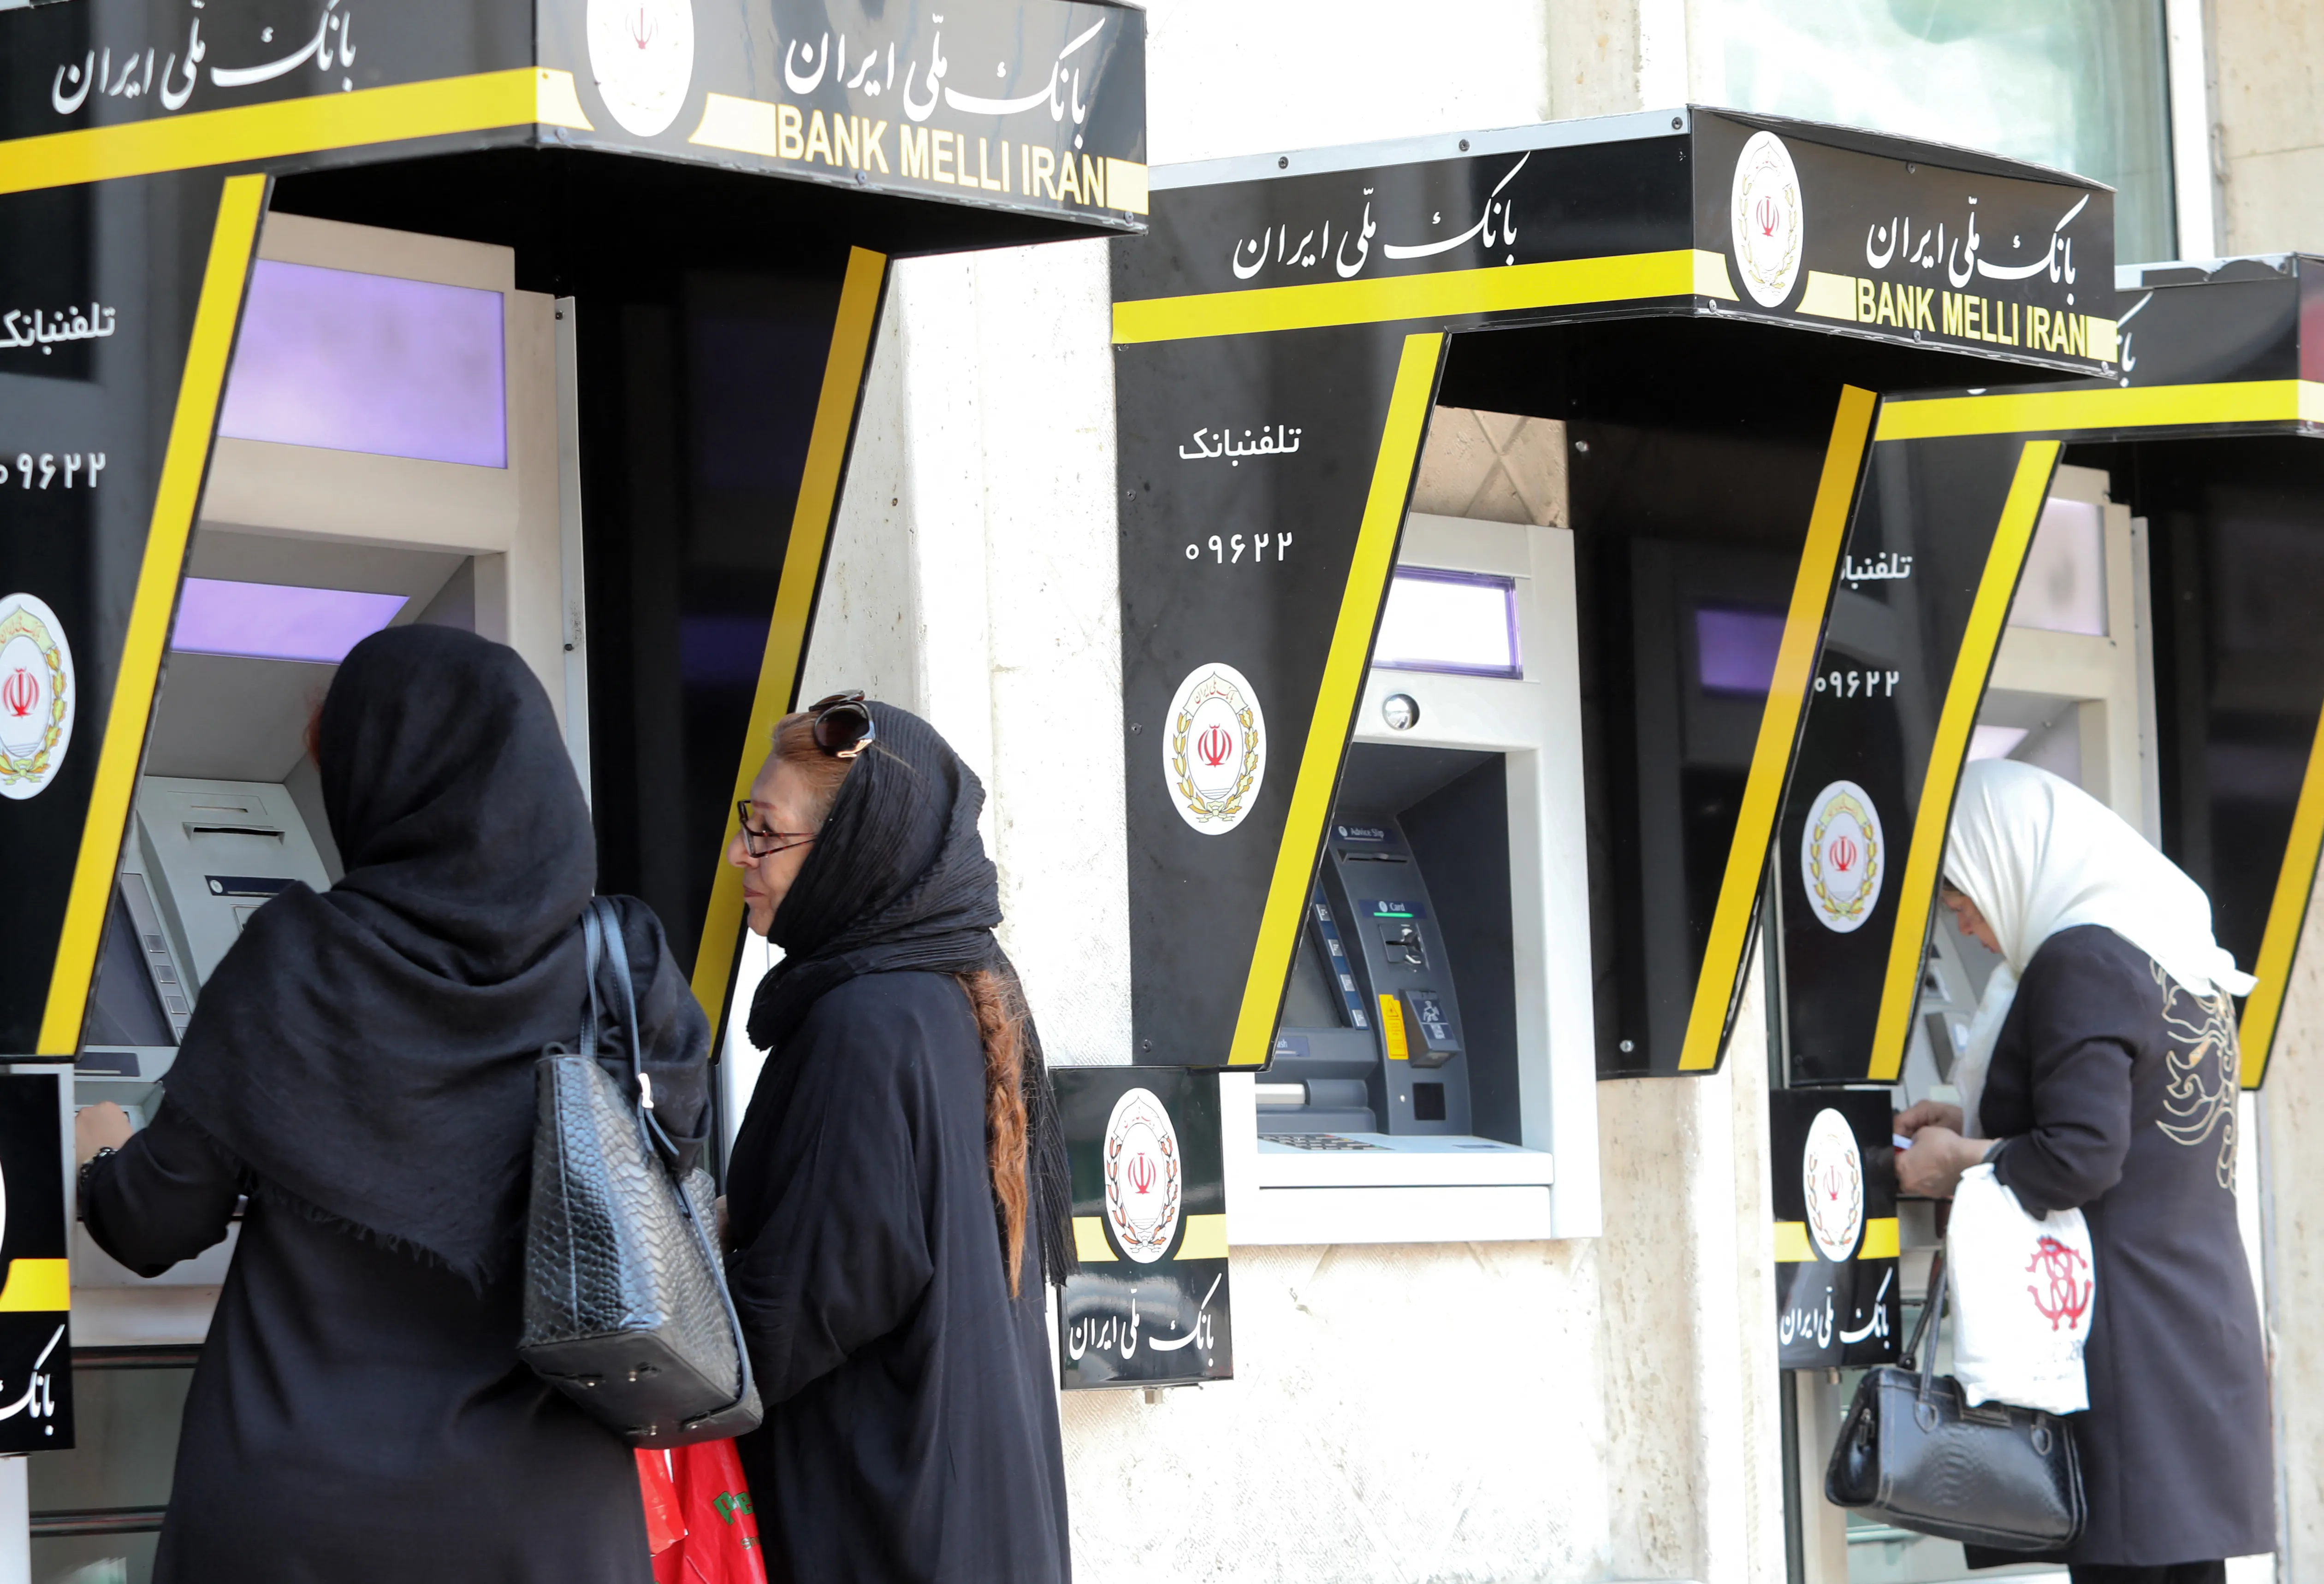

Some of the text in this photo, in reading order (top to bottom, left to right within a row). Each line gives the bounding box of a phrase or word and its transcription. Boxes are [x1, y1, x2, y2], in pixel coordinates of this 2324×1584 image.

[53, 47, 155, 115] ایران
[784, 32, 895, 97] ایران
[943, 17, 1106, 150] بانک
[777, 104, 1105, 208] BANK MELLI IRAN
[1383, 150, 1531, 266] بانک
[1232, 219, 1329, 280] ایران
[1866, 216, 1944, 270] ایران
[1976, 193, 2090, 306] بانک
[1857, 278, 2087, 357] BANK MELLI IRAN
[1179, 424, 1302, 467] تلفنبانک
[1185, 532, 1293, 564] ۰۹۶۲۲
[1840, 552, 1913, 590] تلفنبا
[1389, 902, 1406, 911] Card
[1276, 1038, 1288, 1048] ash
[1069, 1316, 1117, 1360] ایران
[1779, 1307, 1819, 1346] ایران
